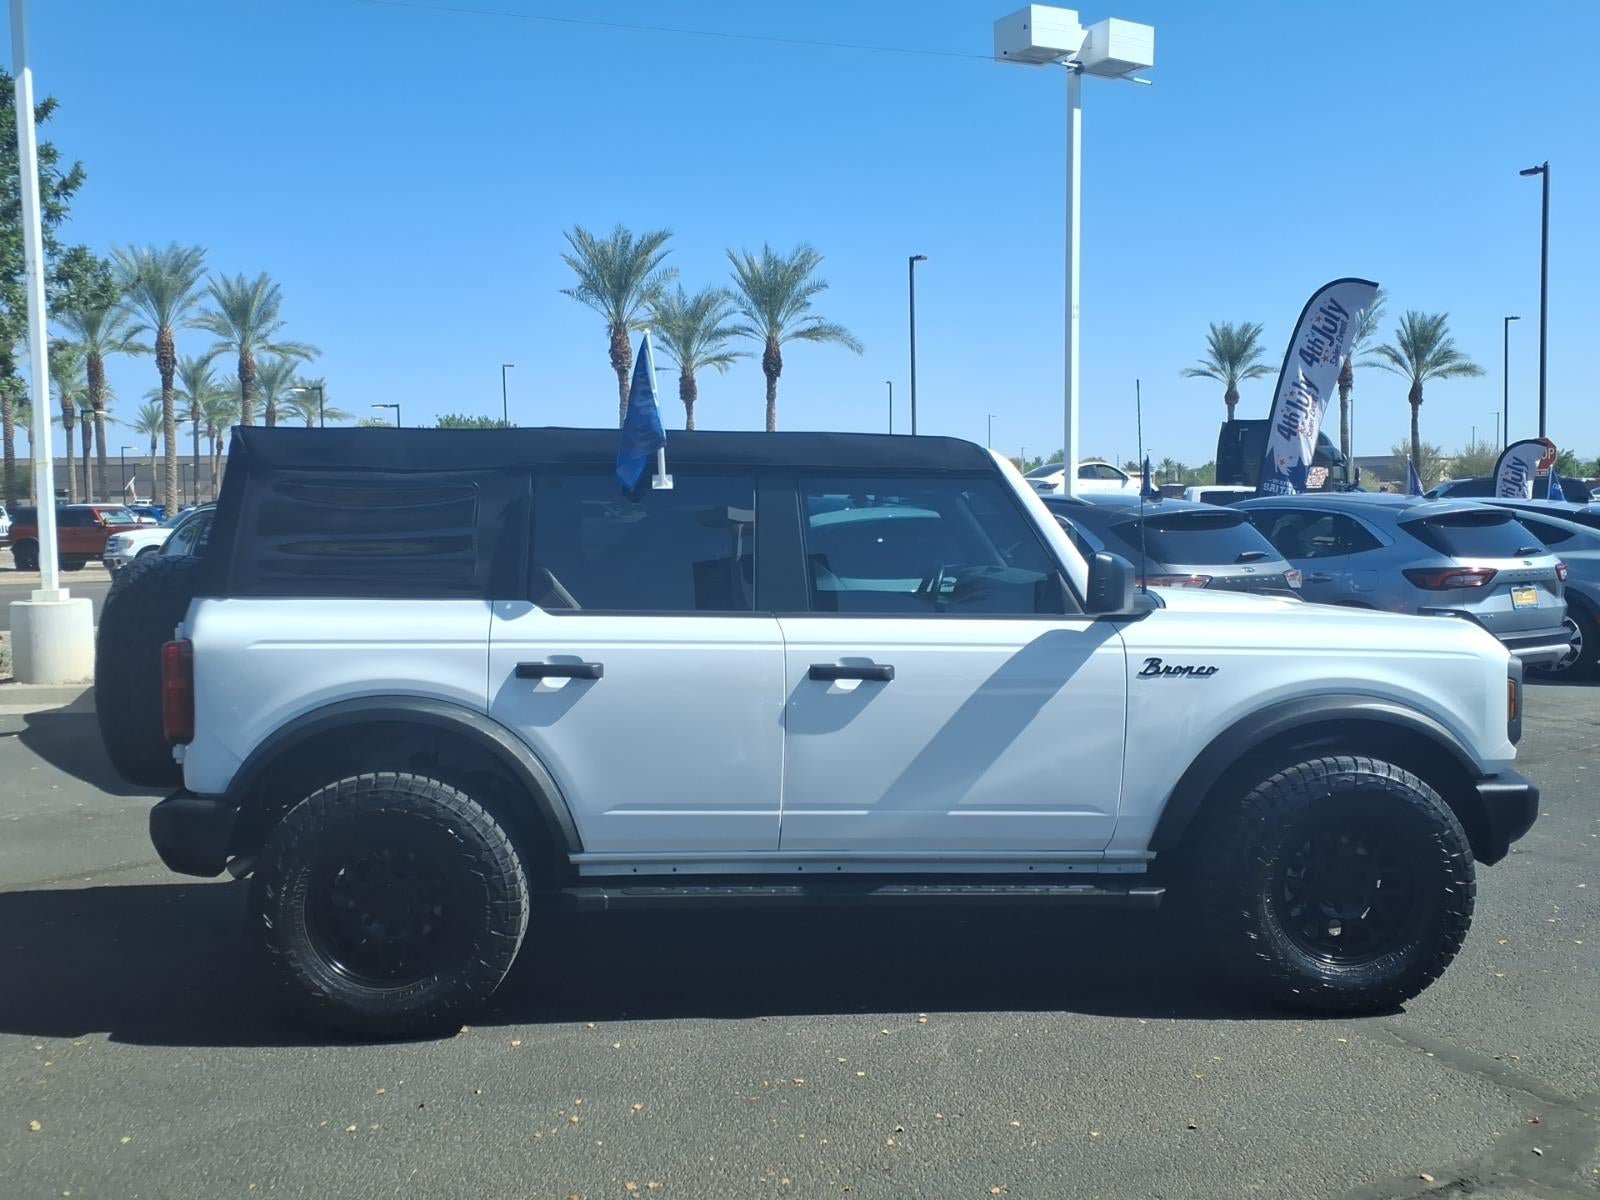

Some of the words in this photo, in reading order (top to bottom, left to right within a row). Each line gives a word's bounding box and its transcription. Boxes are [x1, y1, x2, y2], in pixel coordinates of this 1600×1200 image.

[1299, 337, 1324, 368] 4th
[1312, 297, 1350, 347] July
[1286, 373, 1319, 420] July
[1277, 413, 1301, 442] 4th
[1502, 456, 1528, 492] July
[1139, 657, 1219, 676] Bronco
